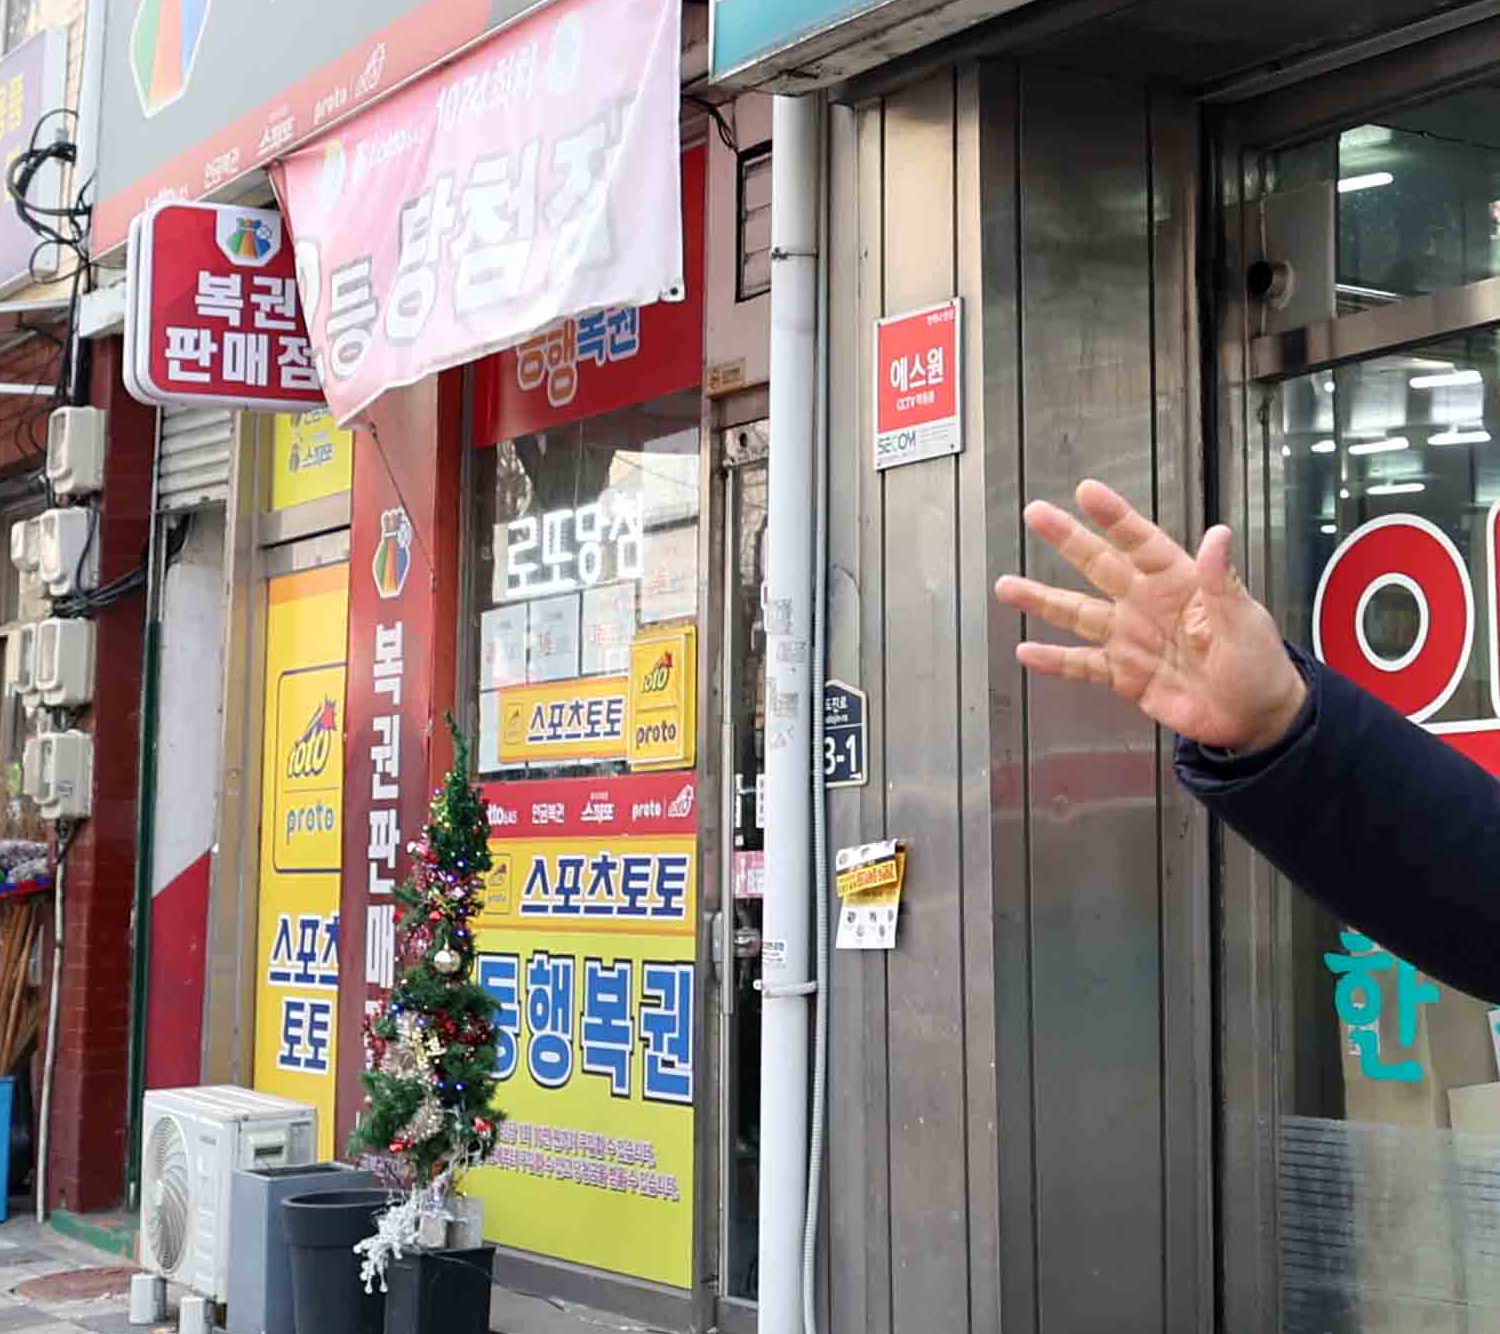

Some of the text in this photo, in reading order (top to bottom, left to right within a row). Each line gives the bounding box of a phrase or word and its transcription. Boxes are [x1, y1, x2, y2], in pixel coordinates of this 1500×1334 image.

[194, 270, 297, 331] 복권
[165, 327, 323, 390] 판매점
[890, 346, 944, 393] 에스원
[877, 429, 917, 455] SECOM
[286, 717, 332, 779] toto
[526, 697, 625, 745] 스포츠토토
[635, 722, 677, 750] proto
[286, 802, 335, 844] proto
[631, 800, 661, 821] proto
[365, 621, 404, 1067] 복권판매
[519, 850, 690, 920] 스포츠토토
[276, 996, 332, 1071] 토토
[476, 948, 693, 1106] 동행복권
